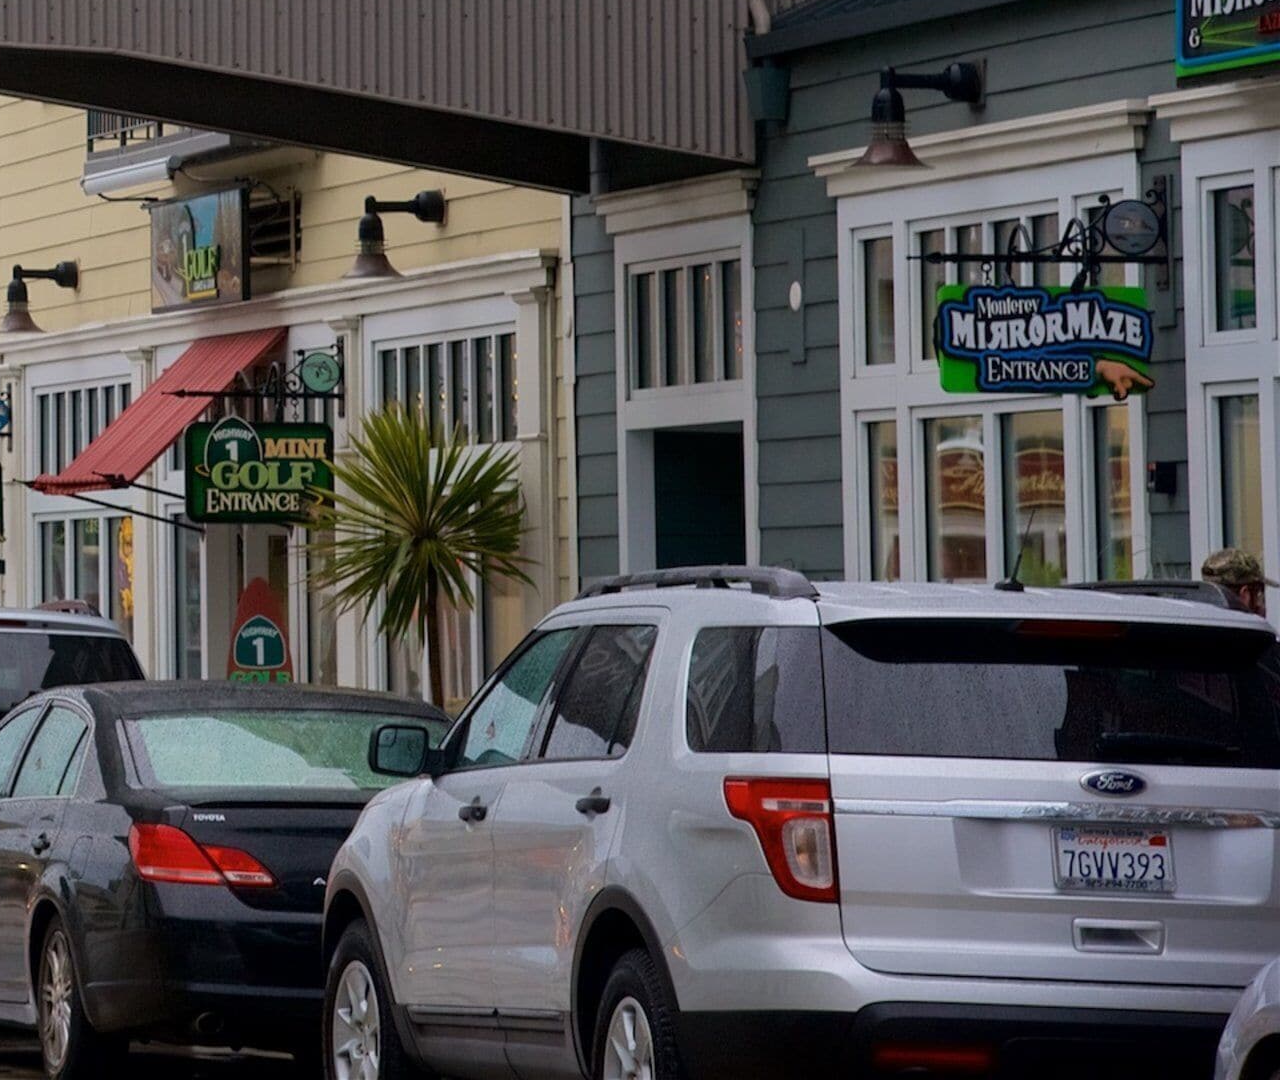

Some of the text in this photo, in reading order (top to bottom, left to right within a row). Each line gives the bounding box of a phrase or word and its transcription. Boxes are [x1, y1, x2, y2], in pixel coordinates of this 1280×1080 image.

[977, 296, 1040, 318] Monterey
[987, 356, 1090, 382] ENTRANCE
[212, 428, 254, 443] HIGHWAY
[225, 440, 238, 462] 1
[263, 438, 326, 458] MINI
[211, 460, 315, 490] GOLF
[206, 488, 300, 513] ENTRANCE
[252, 637, 265, 666] 1
[1096, 774, 1134, 791] Ford
[192, 813, 226, 822] TOYOTA
[1063, 850, 1166, 880] 7GVV393
